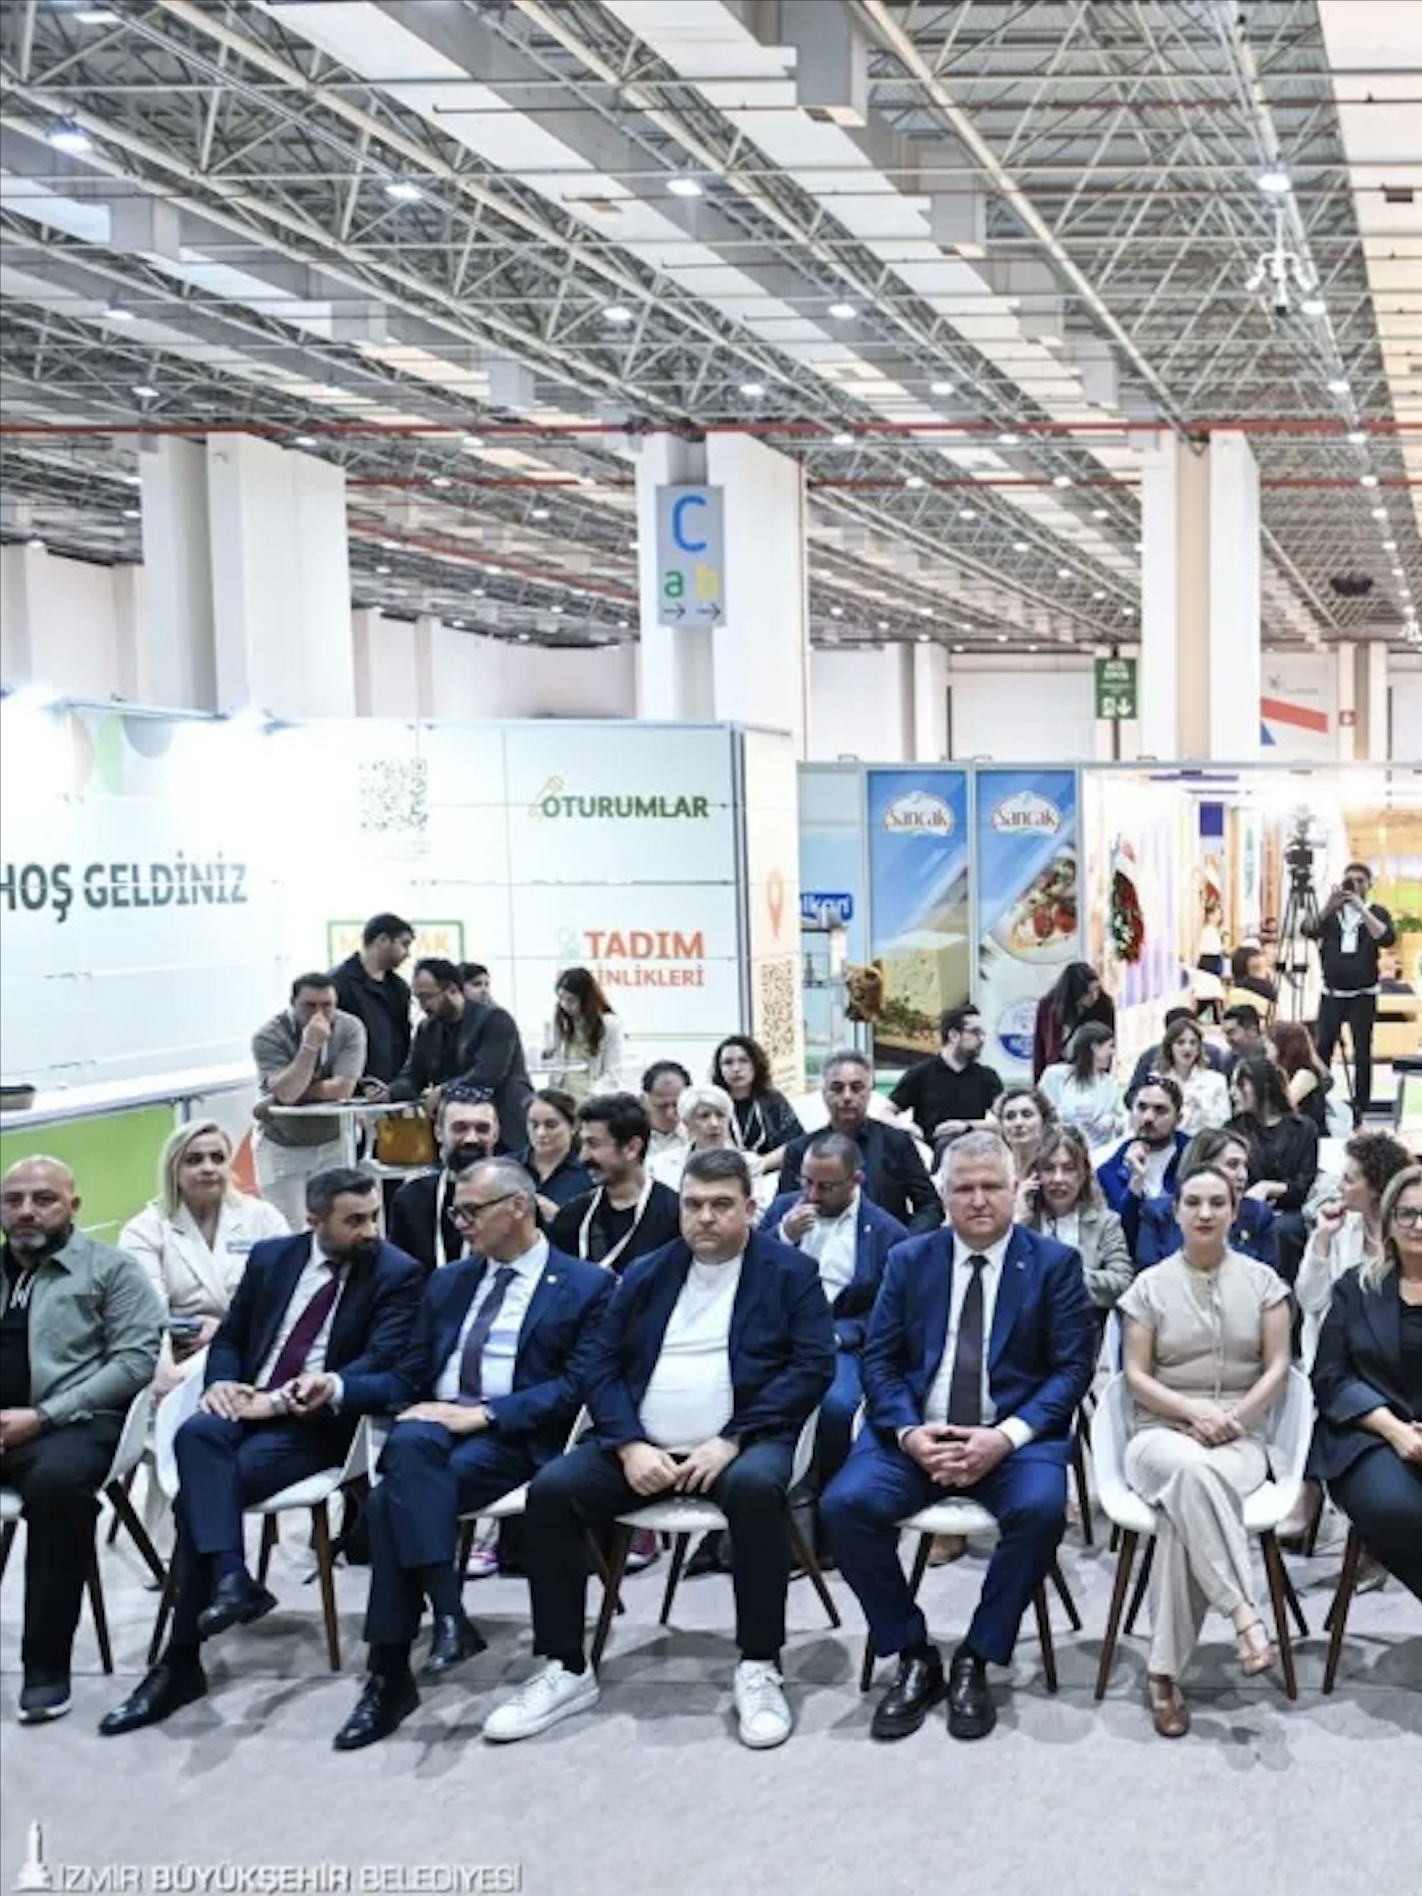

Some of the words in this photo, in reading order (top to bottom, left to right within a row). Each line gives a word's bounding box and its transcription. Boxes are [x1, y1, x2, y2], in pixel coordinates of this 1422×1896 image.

[672, 494, 707, 552] C
[664, 571, 684, 598] a
[542, 795, 709, 818] OTURUMLAR
[0, 863, 73, 923] HOŞ
[83, 849, 248, 909] GELDİNİZ
[583, 931, 705, 959] TADIM
[558, 963, 705, 987] İNLİKLERİ
